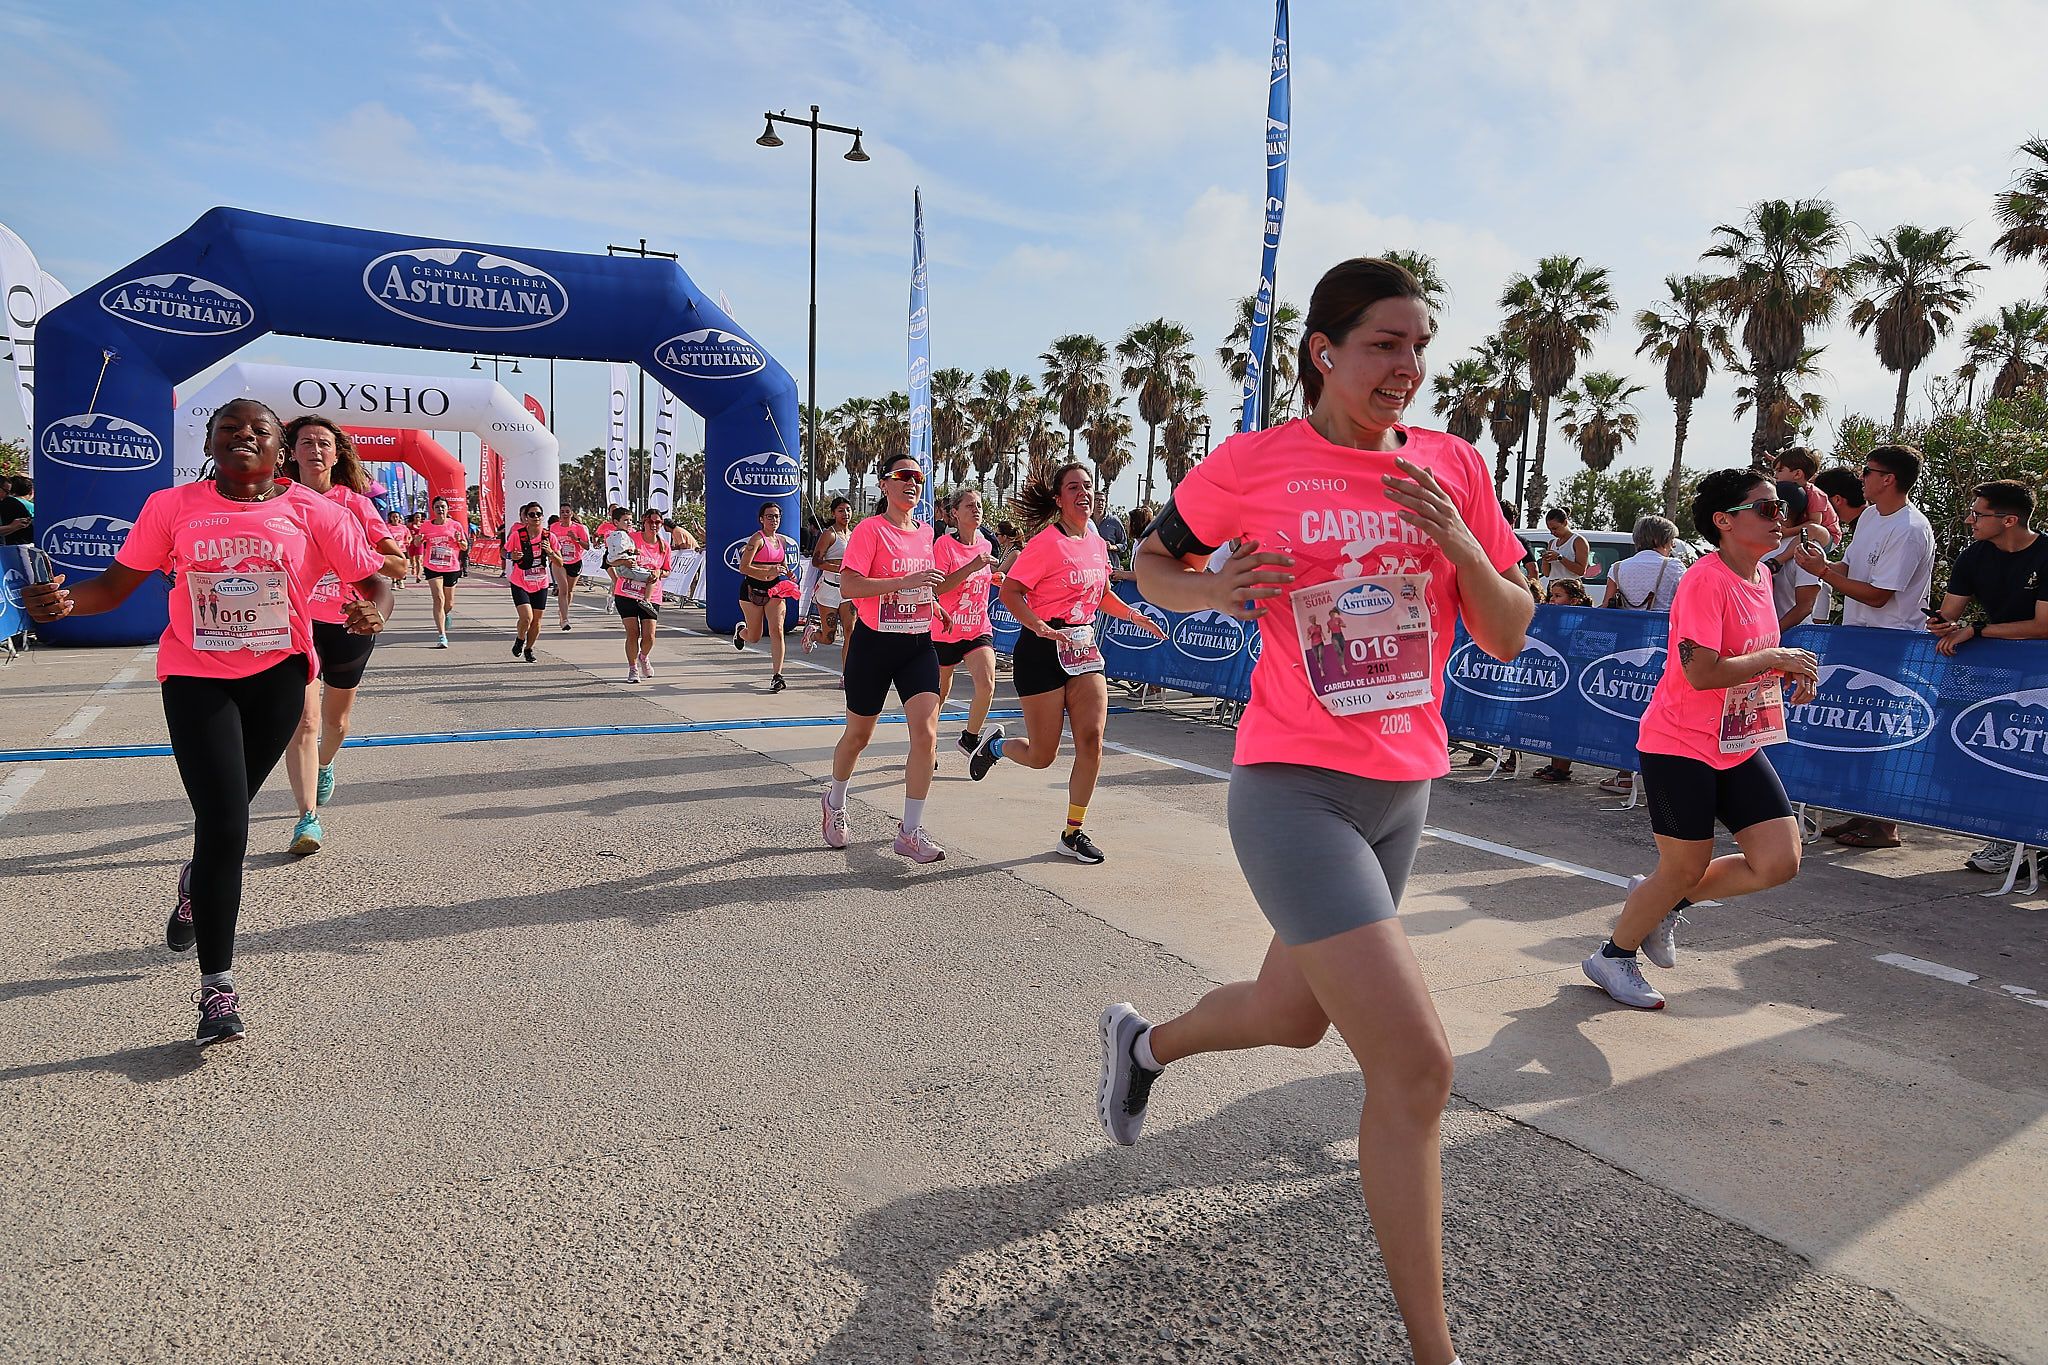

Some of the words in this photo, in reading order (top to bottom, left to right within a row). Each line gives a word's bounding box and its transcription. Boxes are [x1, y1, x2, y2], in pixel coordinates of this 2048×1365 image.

[413, 266, 478, 282] CENTRAL
[484, 275, 548, 289] LECHERA
[379, 264, 554, 316] ASTURIANA
[136, 289, 188, 301] CENTRAL
[193, 296, 241, 309] LECHERA
[110, 289, 243, 326] ASTURIANA
[663, 346, 762, 366] ASTURIANA
[292, 379, 450, 417] OYSHO
[491, 422, 535, 433] OYSHO
[62, 430, 107, 439] CENTRAL
[111, 434, 152, 444] LECHERA
[47, 431, 156, 461] ASTURIANA
[515, 479, 555, 490] OYSHO
[1287, 478, 1347, 494] OYSHO
[189, 516, 230, 529] OYSHO
[63, 532, 107, 541] CENTRAL
[47, 533, 122, 557] ASTURI
[194, 537, 284, 562] CARRERA
[898, 604, 917, 613] 016
[1305, 595, 1333, 609] SUMA
[1342, 596, 1392, 610] ASTURIANA
[220, 609, 257, 623] 016
[953, 614, 981, 625] MUJER
[205, 639, 235, 647] OYSHO
[1176, 624, 1237, 651] ASTURIANA
[1350, 635, 1399, 662] 016
[1367, 663, 1390, 675] 2101
[1453, 652, 1557, 689] ASTURIANA
[1613, 668, 1659, 681] CENTRAL
[1324, 680, 1356, 693] CARRERA
[1357, 679, 1365, 687] DE
[1366, 677, 1376, 685] LA
[1376, 674, 1397, 684] MUJER
[1401, 670, 1424, 681] VALENCIA
[1395, 688, 1424, 700] Santander
[1379, 713, 1411, 735] 2026
